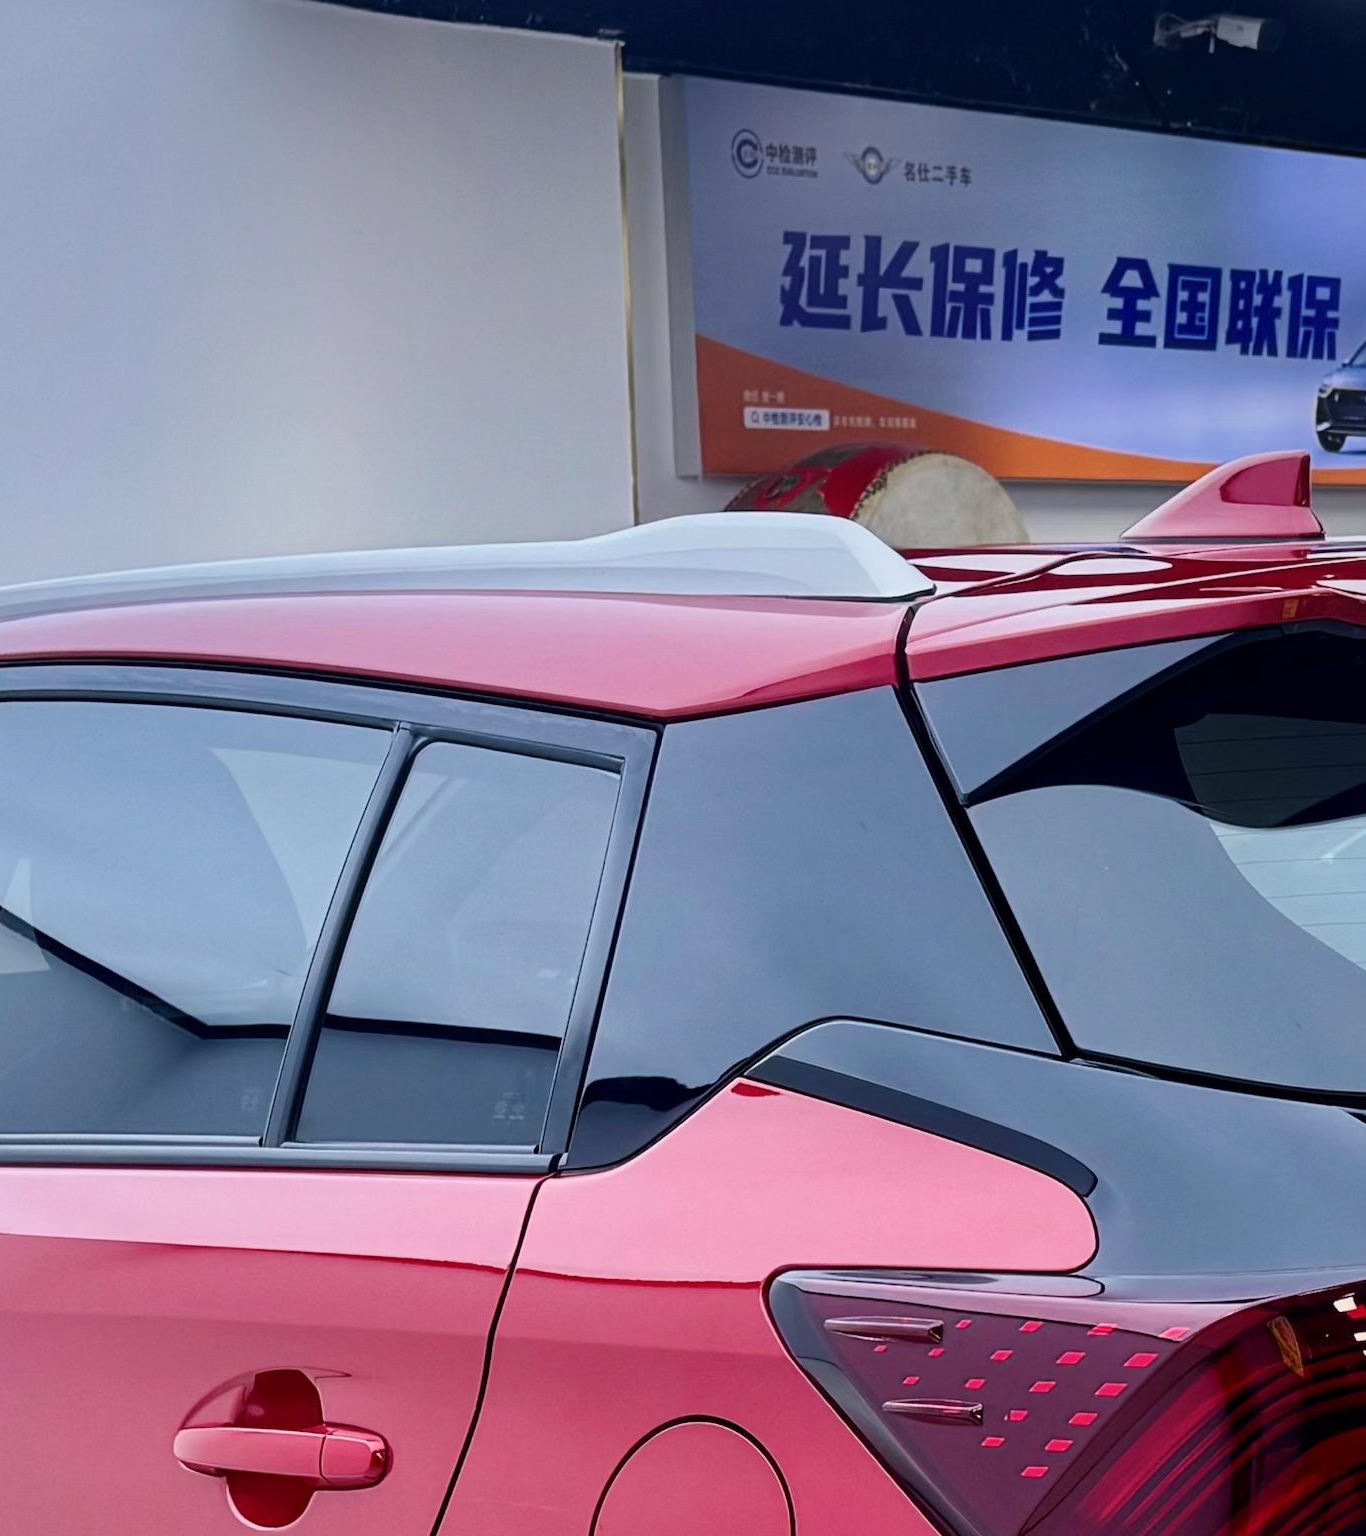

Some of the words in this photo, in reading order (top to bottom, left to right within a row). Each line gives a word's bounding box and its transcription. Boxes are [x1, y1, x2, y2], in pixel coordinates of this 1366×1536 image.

[903, 161, 972, 187] 名仕二手车
[779, 230, 1065, 341] 延长保修
[1098, 256, 1342, 361] 全国联保
